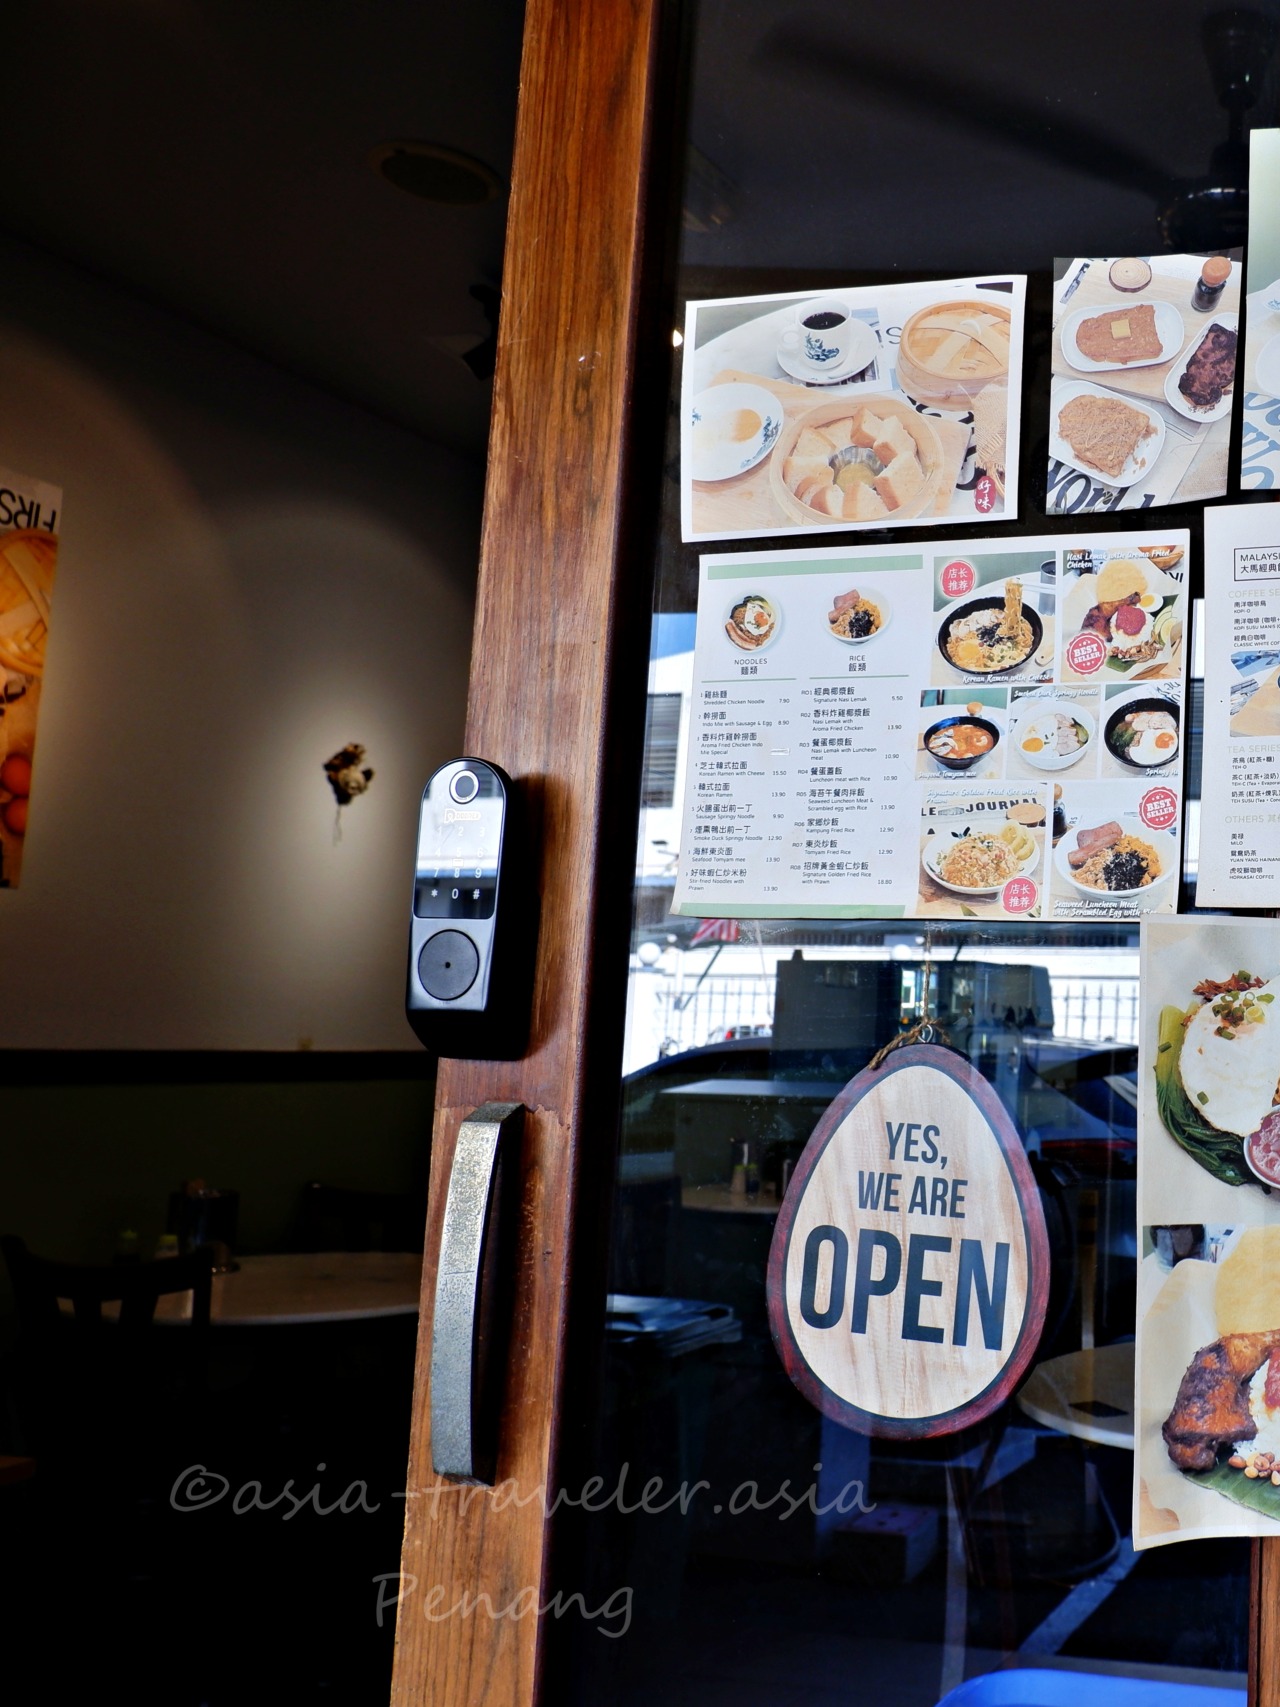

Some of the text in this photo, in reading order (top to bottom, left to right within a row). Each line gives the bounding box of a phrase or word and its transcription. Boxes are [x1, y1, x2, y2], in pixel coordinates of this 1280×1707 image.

[978, 480, 991, 509] 好味
[948, 568, 968, 579] 店长
[948, 581, 968, 591] 推荐
[1228, 590, 1265, 598] COFFEE
[1074, 644, 1098, 657] BEST
[1074, 652, 1100, 664] SELLER
[849, 663, 866, 672] 飯類
[1147, 798, 1171, 813] BEST
[922, 807, 936, 816] LE
[1147, 806, 1175, 819] SELLER
[1225, 815, 1264, 823] OTHERS
[434, 868, 482, 878] 7 8 9
[452, 889, 458, 899] 0
[1010, 884, 1030, 895] 店长
[1009, 897, 1030, 908] 推荐
[1109, 909, 1122, 918] Egg
[886, 1122, 948, 1170] YES,
[858, 1171, 968, 1219] WE ARE
[801, 1224, 1010, 1351] OPEN
